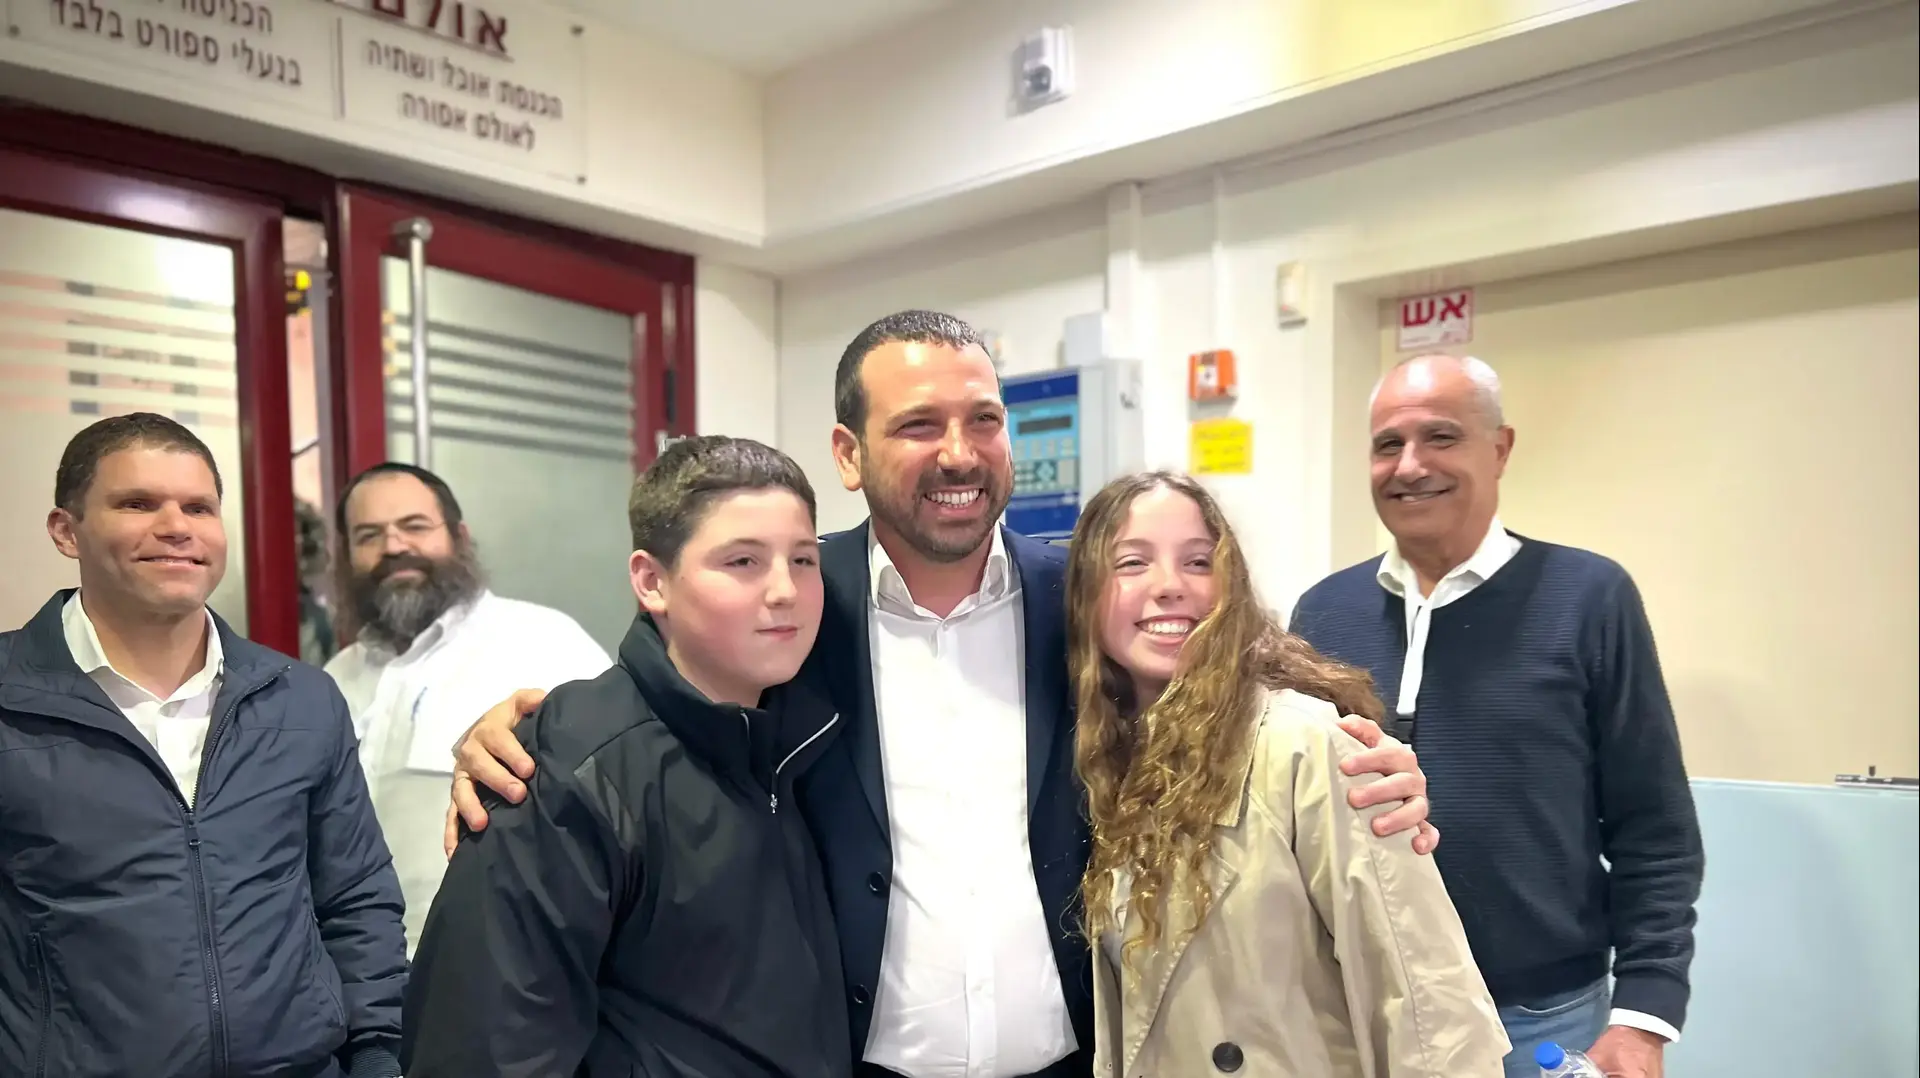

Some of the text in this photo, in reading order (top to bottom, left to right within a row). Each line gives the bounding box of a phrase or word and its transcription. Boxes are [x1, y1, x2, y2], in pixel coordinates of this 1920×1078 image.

[52, 0, 302, 85] בנעלי ספורט בלבד
[367, 39, 563, 119] הכנסת אוכל ושתיה
[401, 91, 535, 151] לאולם אסורה
[1402, 293, 1467, 328] אש
